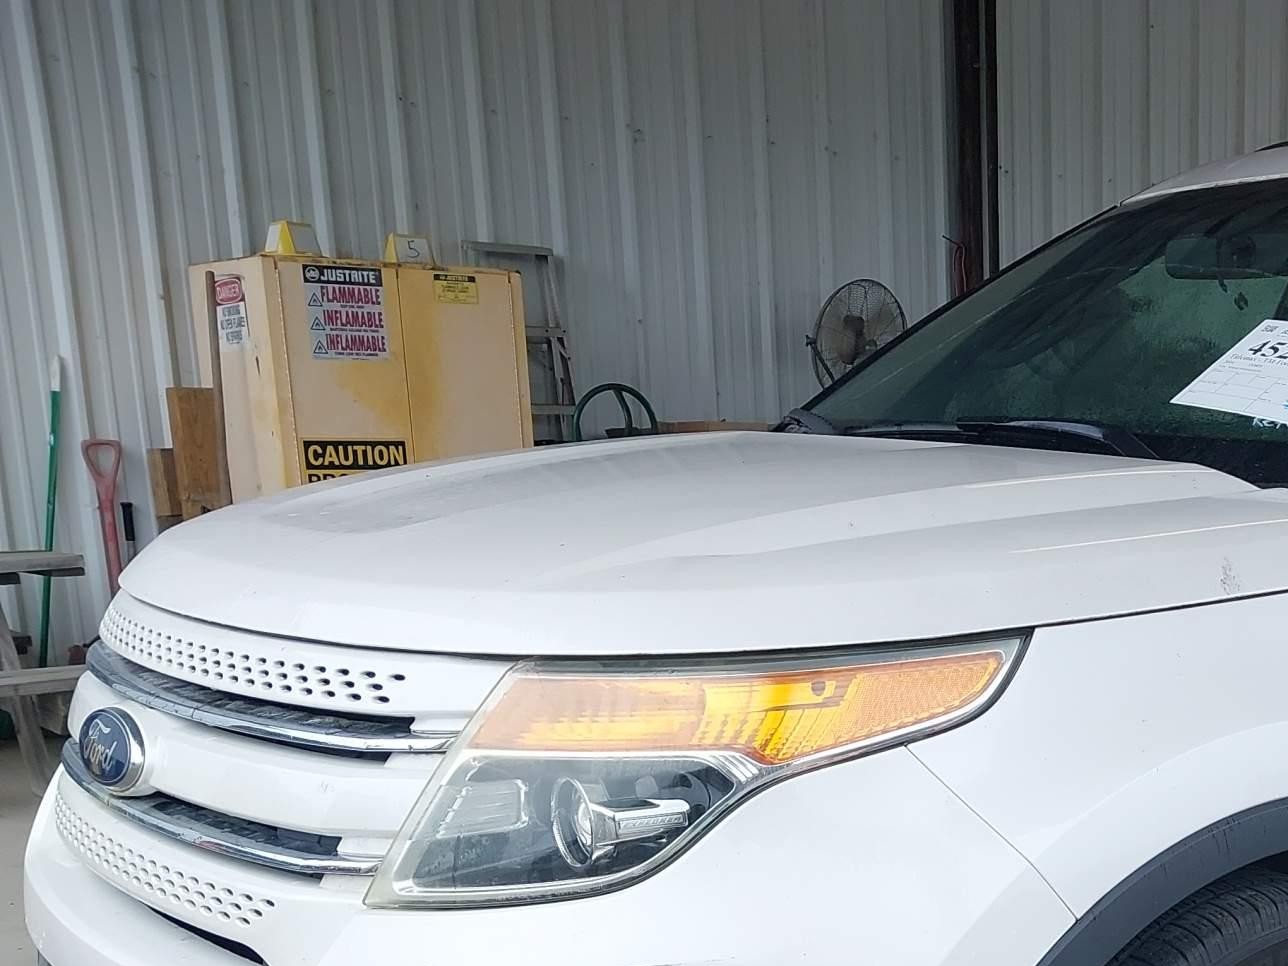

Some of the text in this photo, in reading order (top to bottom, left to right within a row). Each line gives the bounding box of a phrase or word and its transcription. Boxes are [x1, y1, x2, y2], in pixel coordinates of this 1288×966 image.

[407, 240, 420, 259] 5
[320, 269, 376, 284] JUSTRITE
[320, 286, 381, 306] FLAMMABLE
[323, 310, 384, 329] INFLAMABLE
[326, 334, 387, 353] INFLAMMABLE
[307, 445, 405, 466] CAUTION
[83, 718, 118, 772] Ford
